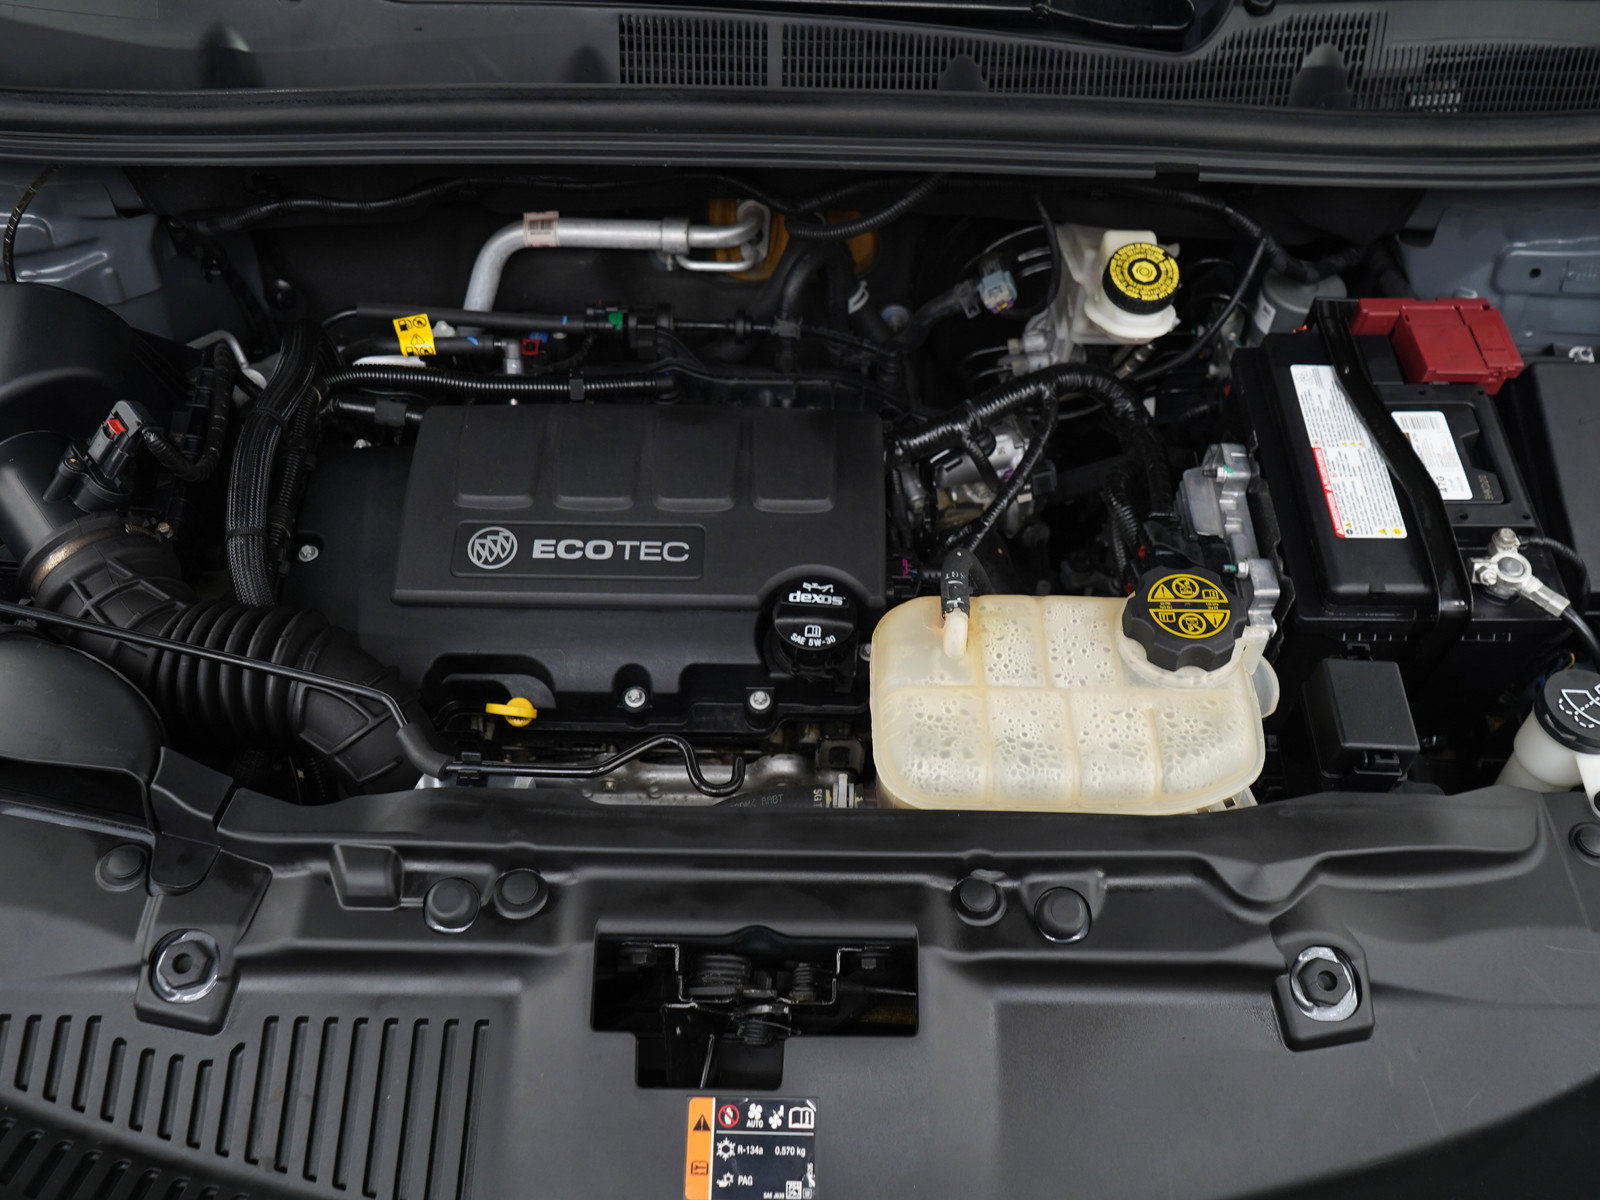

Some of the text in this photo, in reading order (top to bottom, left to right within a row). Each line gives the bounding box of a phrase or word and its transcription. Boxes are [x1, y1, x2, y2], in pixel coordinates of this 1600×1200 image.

[532, 539, 690, 562] ECOTEC
[790, 633, 836, 647] SAE 5W-30
[746, 1120, 764, 1128] AUTO
[738, 1145, 764, 1155] R-134a
[796, 1146, 806, 1158] kg
[738, 1175, 753, 1186] PAG
